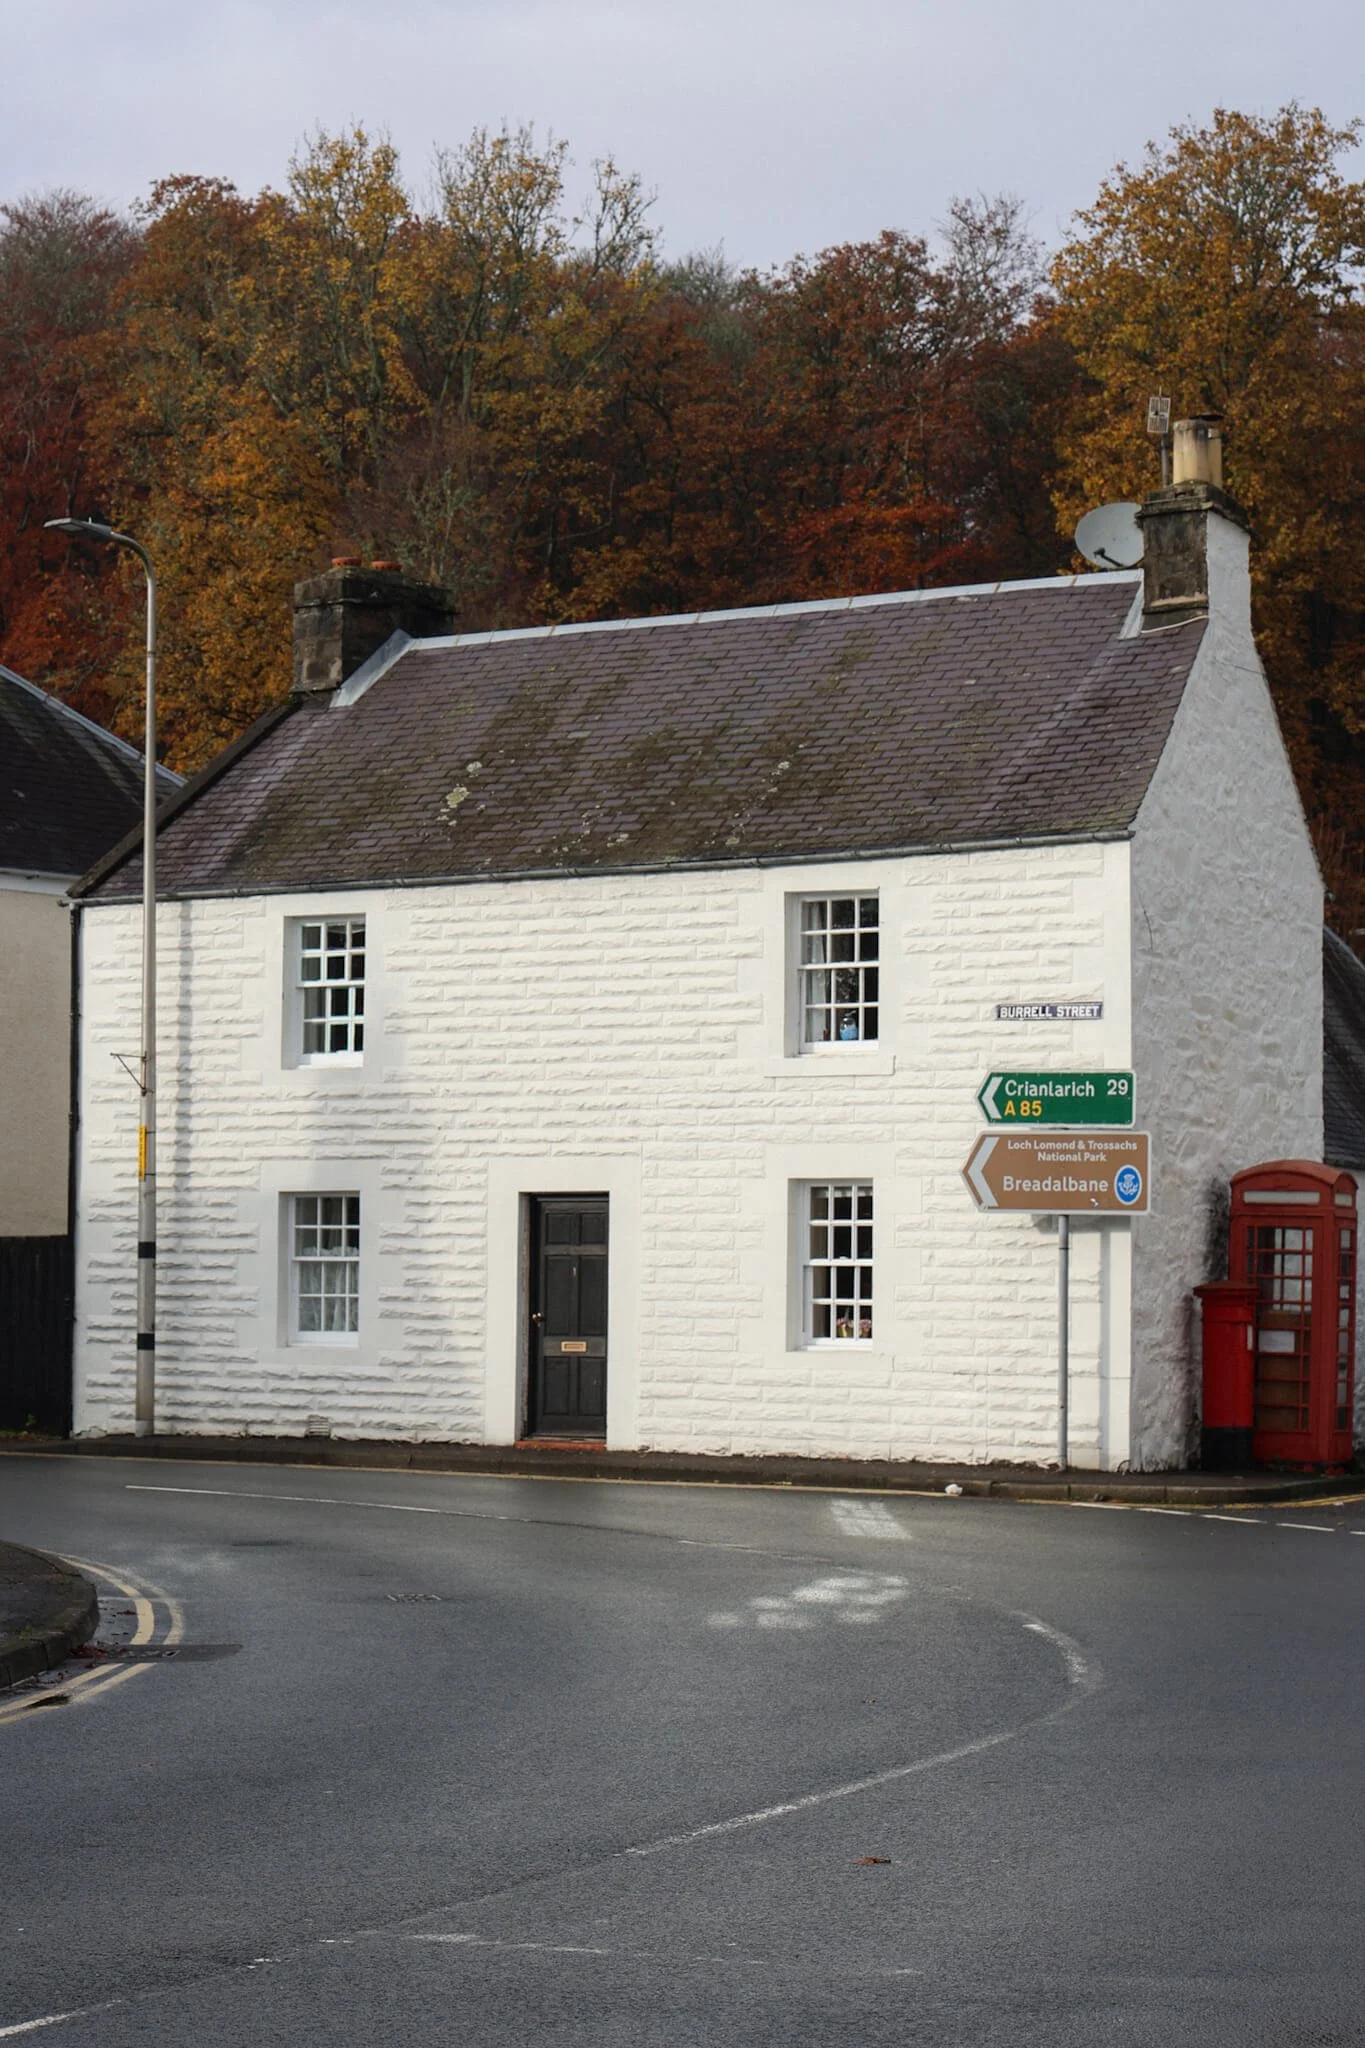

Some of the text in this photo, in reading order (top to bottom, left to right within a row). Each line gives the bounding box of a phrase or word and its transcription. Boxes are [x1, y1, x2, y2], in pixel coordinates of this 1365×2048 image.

[1000, 1005, 1099, 1019] BURRELL STREET
[1005, 1079, 1129, 1097] Crianlarich 29
[1004, 1100, 1042, 1116] A 85
[1007, 1140, 1137, 1150] Loch Lomond & Trossachs
[1037, 1152, 1107, 1162] National Park
[1002, 1175, 1109, 1192] Breadalbane
